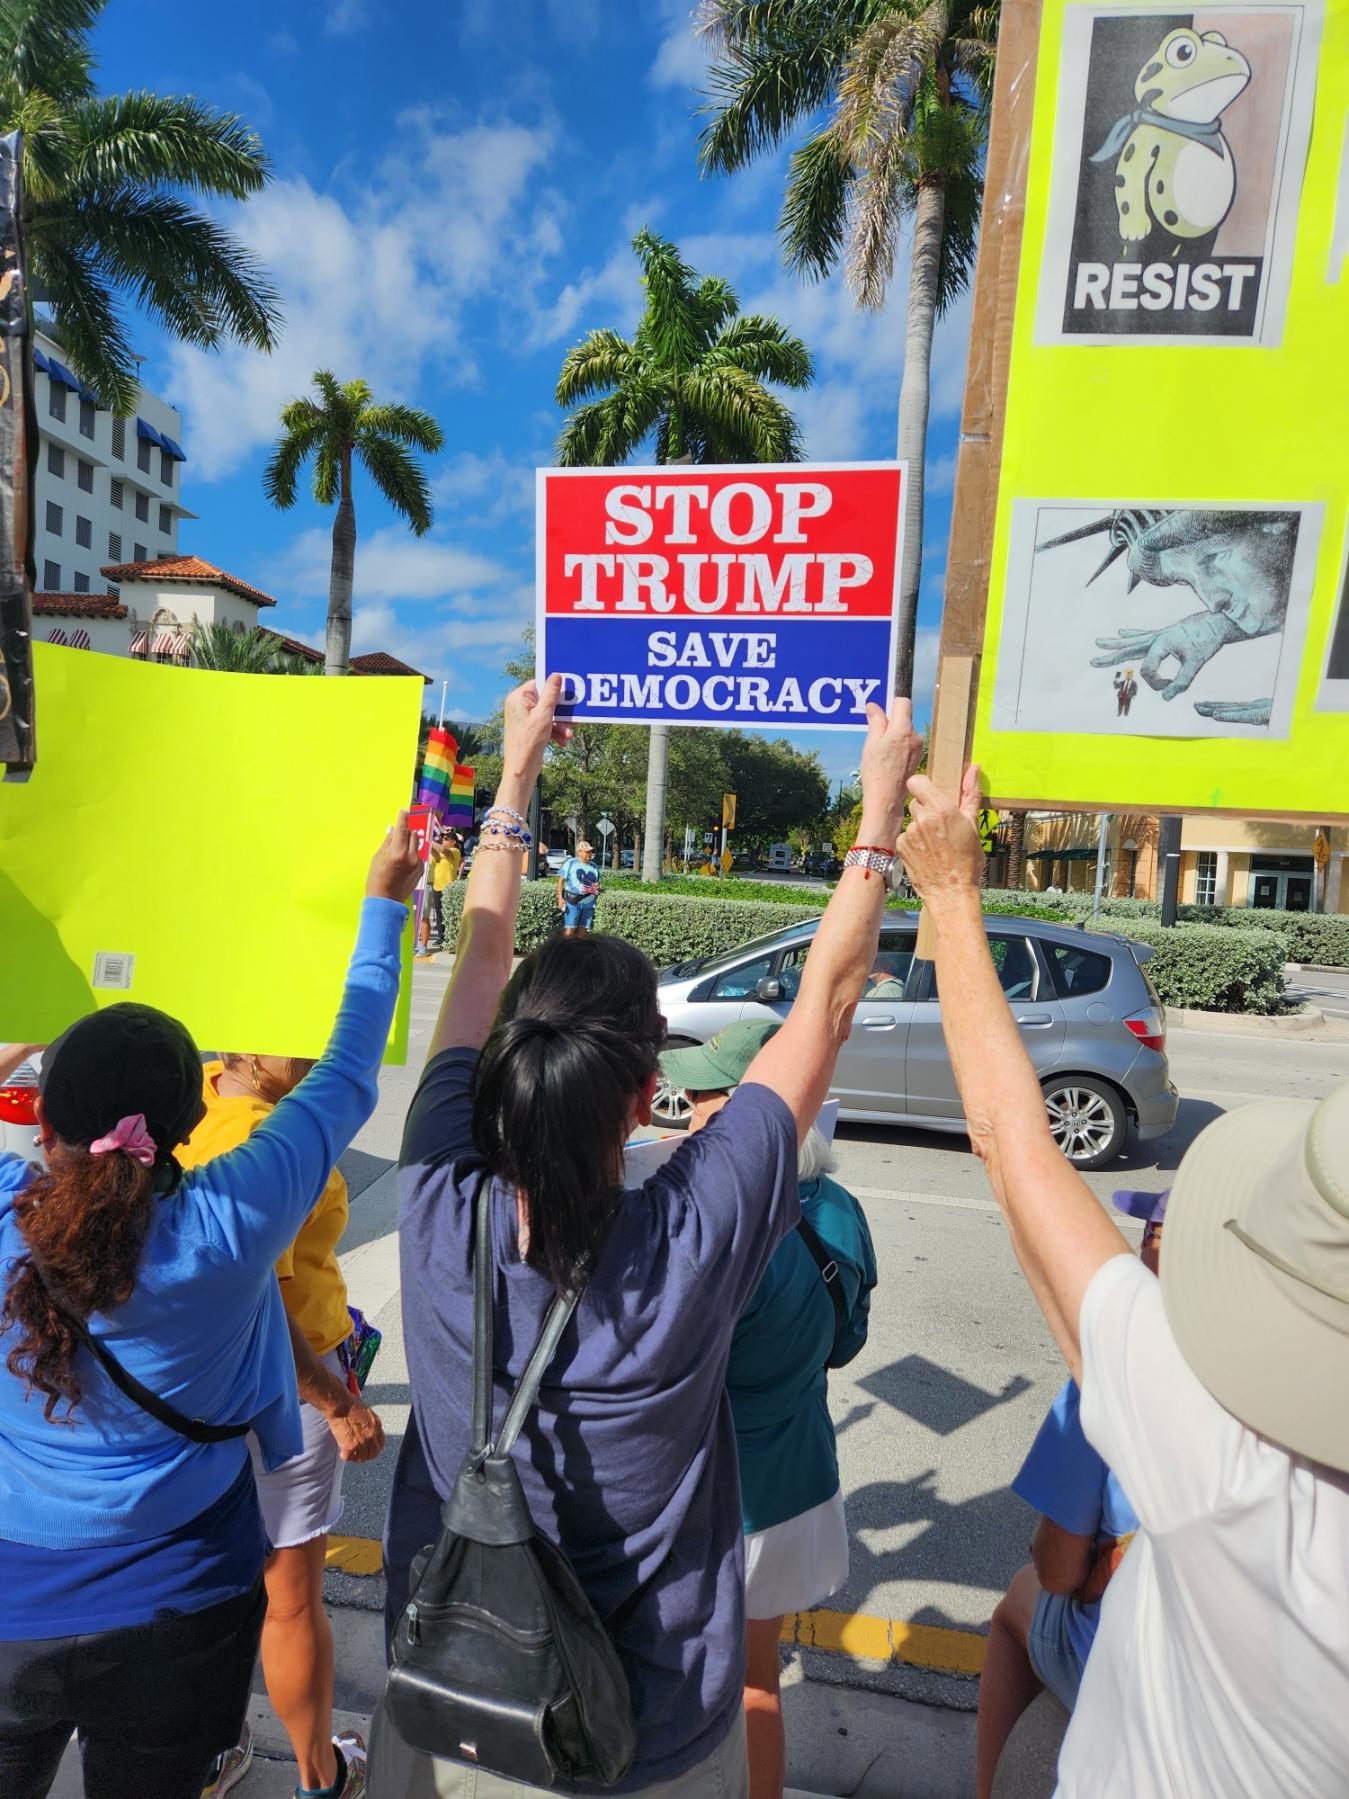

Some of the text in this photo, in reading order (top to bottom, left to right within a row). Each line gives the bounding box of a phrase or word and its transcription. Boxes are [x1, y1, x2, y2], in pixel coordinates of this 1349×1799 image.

[1073, 262, 1256, 311] RESIST
[604, 483, 833, 546] STOP
[564, 553, 874, 613] TRUMP
[647, 631, 777, 669] SAVE
[557, 672, 881, 714] DEMOCRACY
